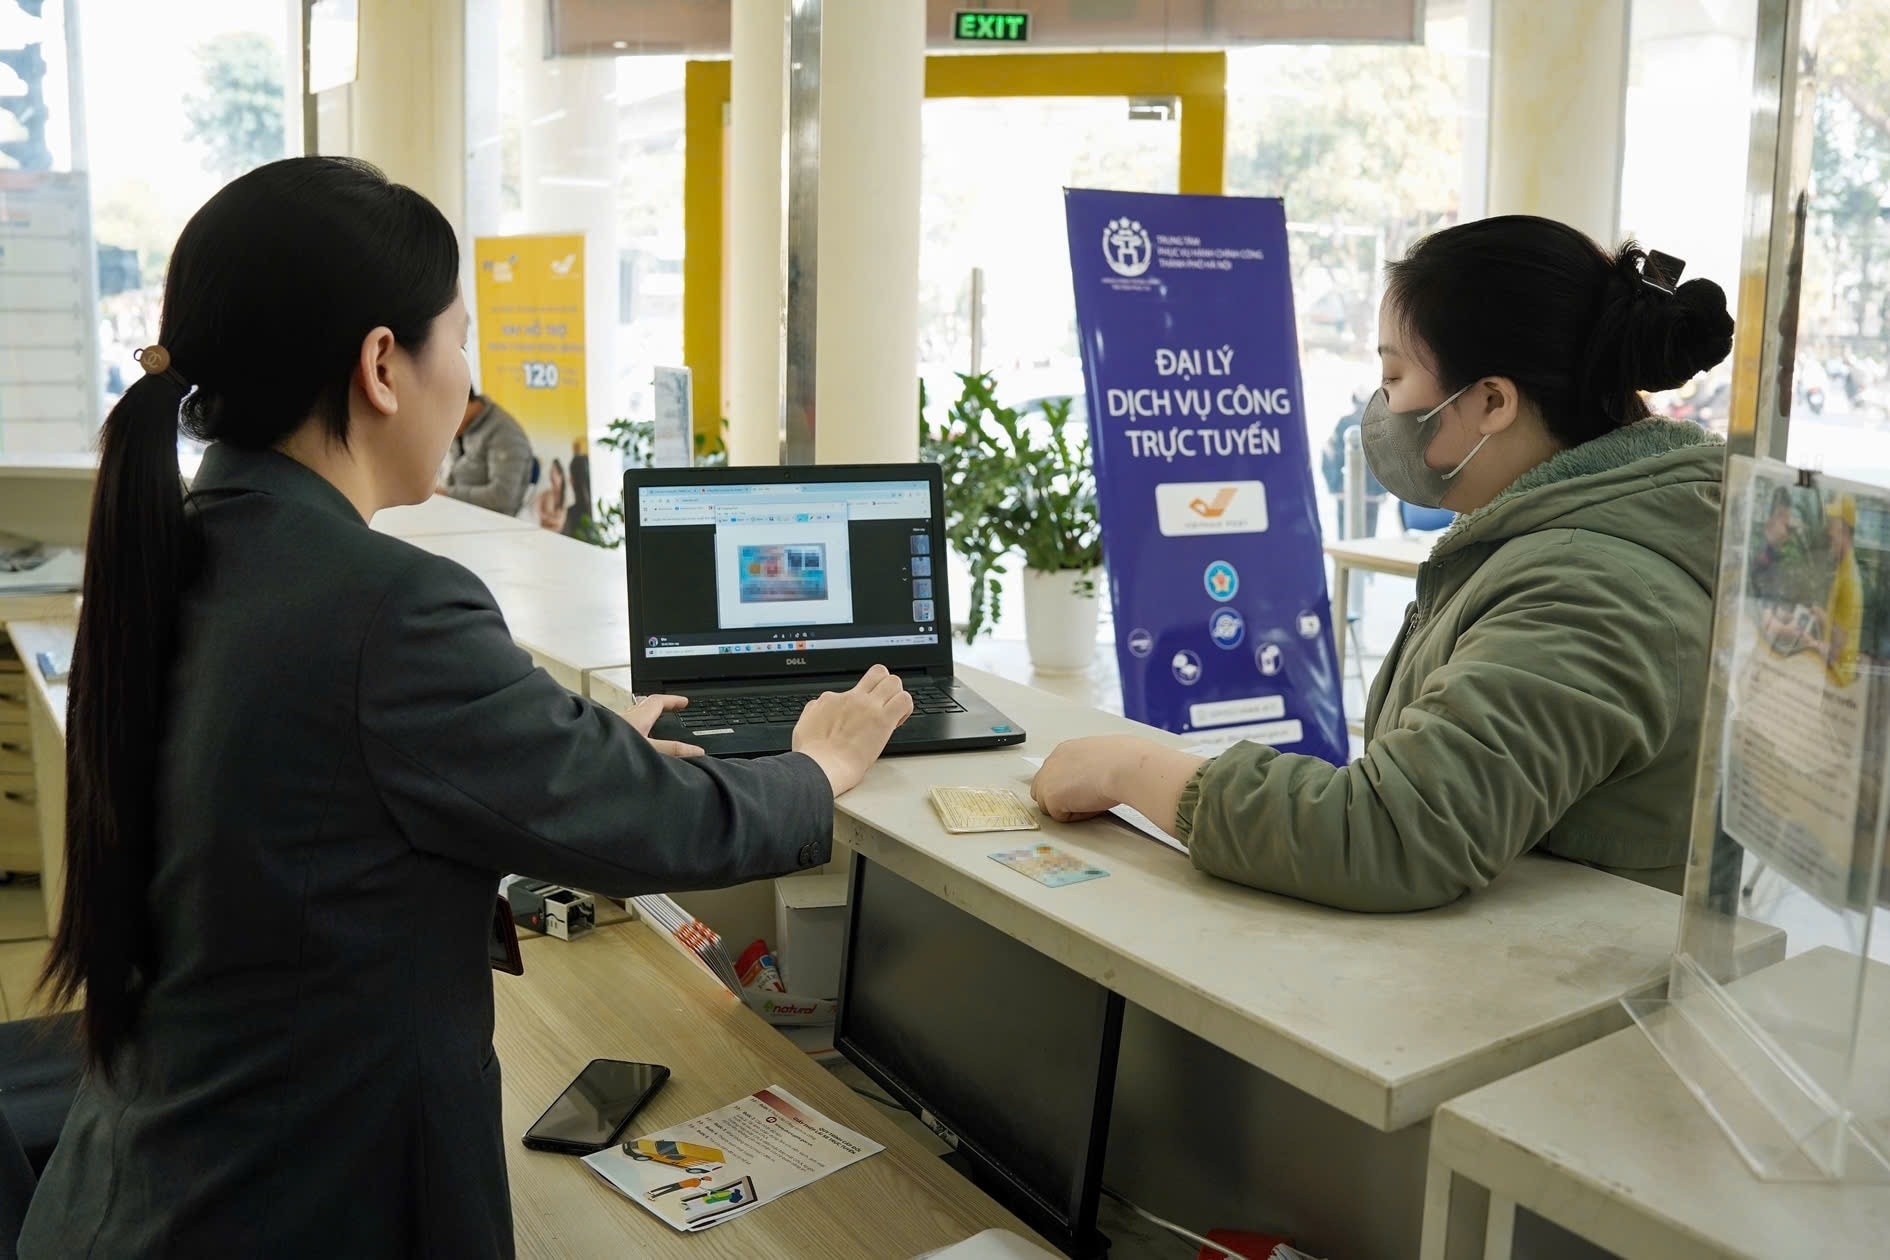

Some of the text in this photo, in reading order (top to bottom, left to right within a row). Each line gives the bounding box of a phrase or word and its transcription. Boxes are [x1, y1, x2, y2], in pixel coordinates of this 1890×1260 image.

[960, 14, 1024, 38] EXIT
[522, 362, 560, 388] 120
[1155, 344, 1234, 381] ĐẠI LÝ
[1107, 384, 1291, 422] DỊCH VỤ CÔNG
[1125, 420, 1281, 463] TRỰC TUYẾN
